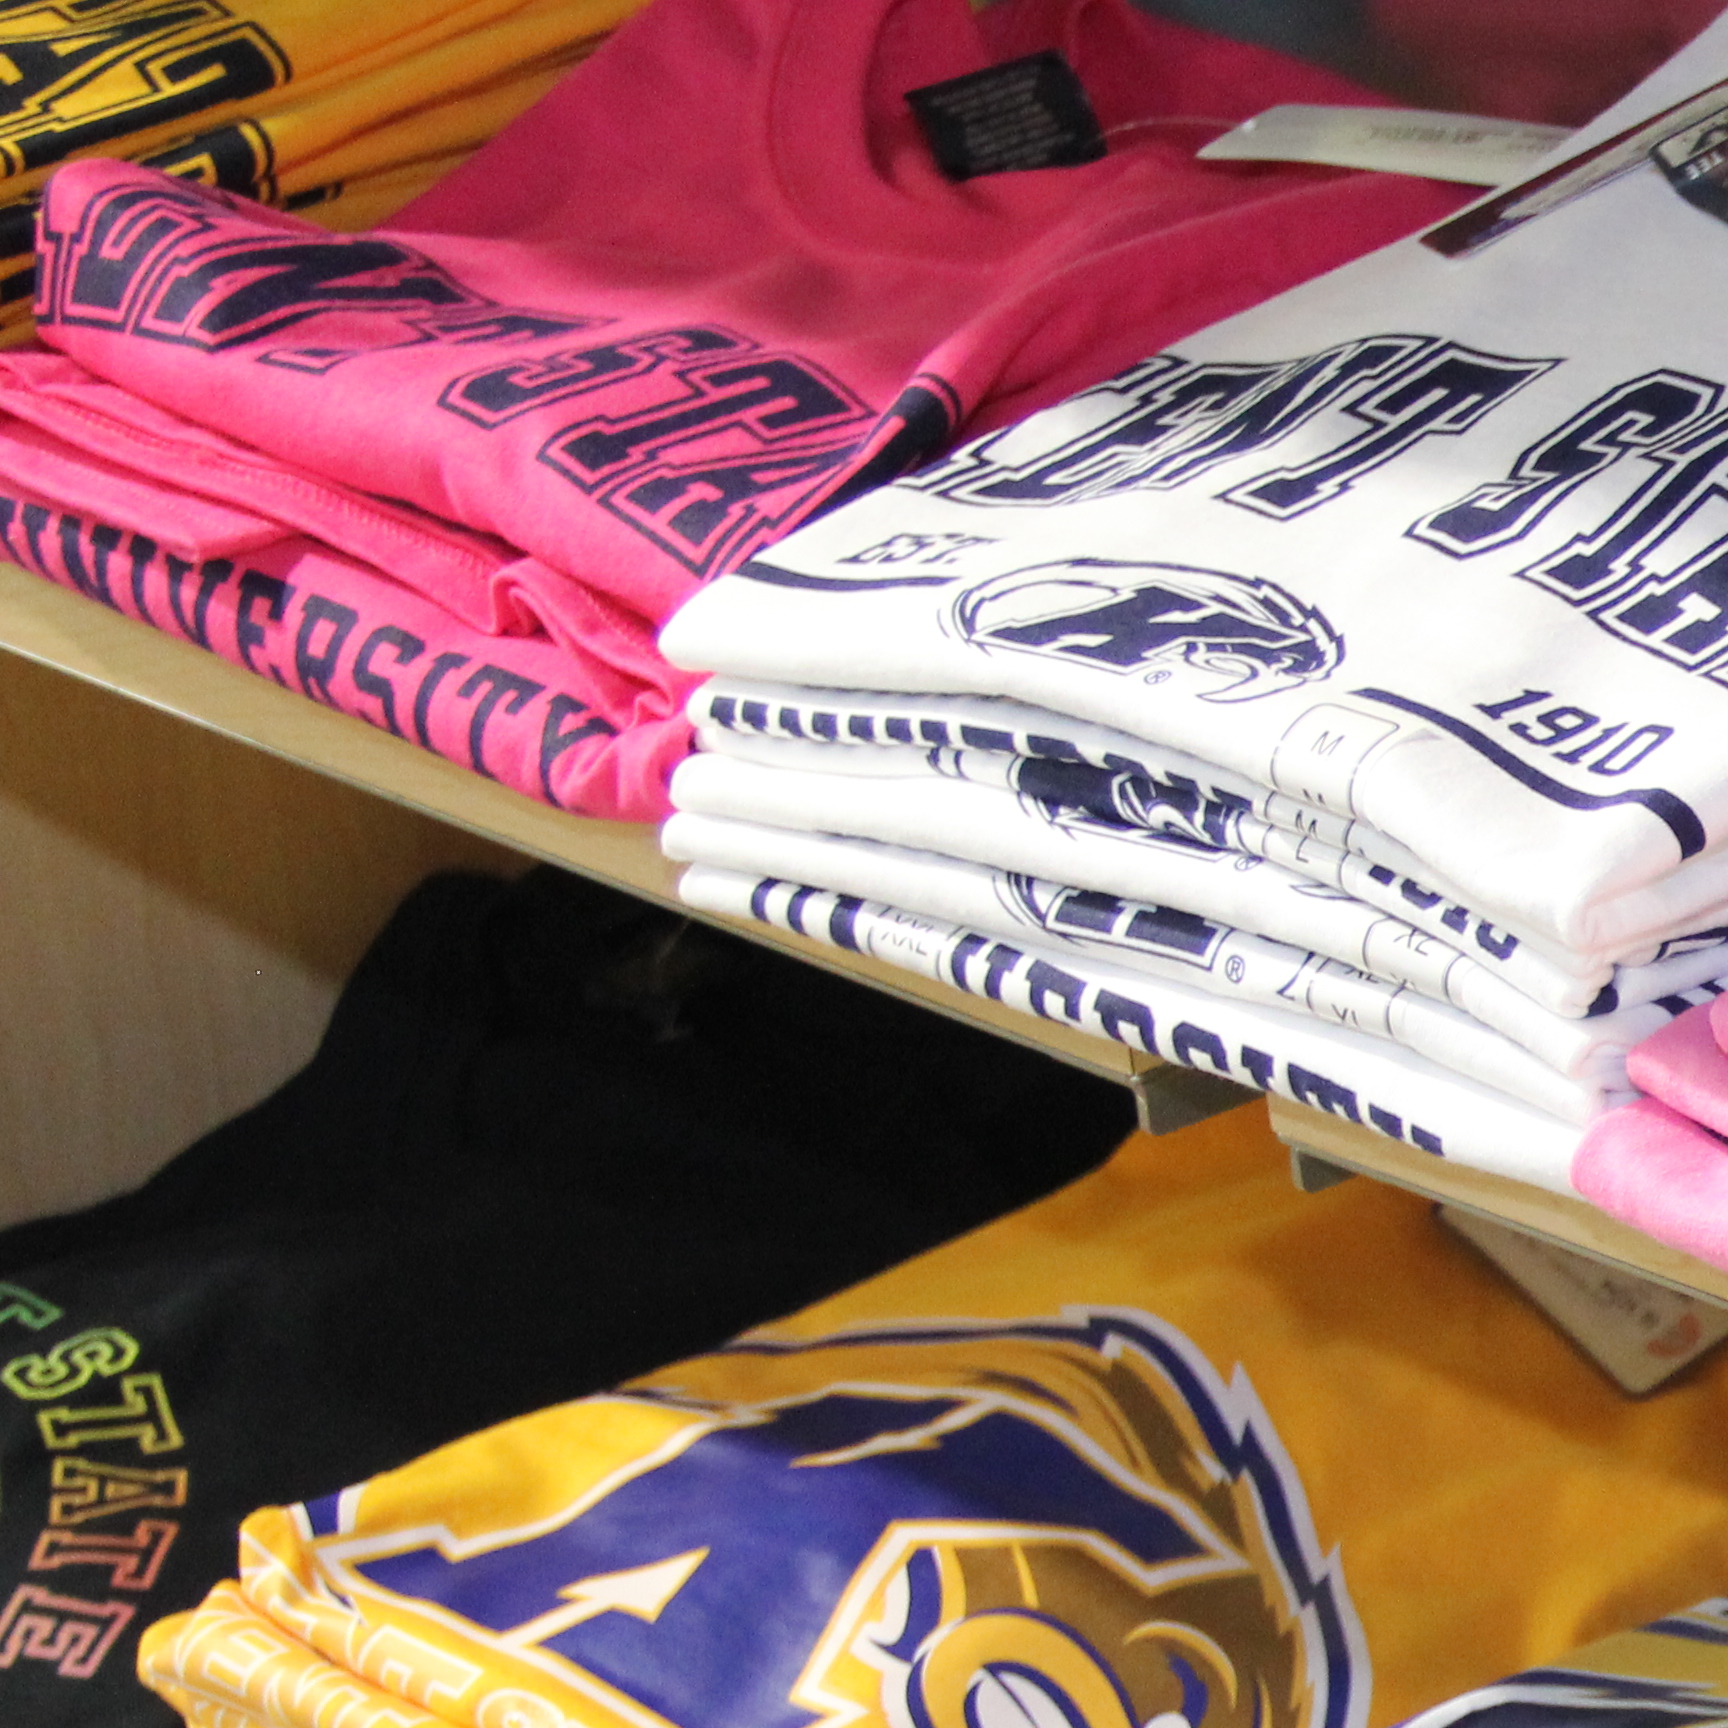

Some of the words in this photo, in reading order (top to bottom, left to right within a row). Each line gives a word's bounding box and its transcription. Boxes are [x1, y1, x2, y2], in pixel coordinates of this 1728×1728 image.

[1683, 148, 1725, 181] TEE
[1310, 730, 1346, 758] M
[1472, 687, 1675, 777] 1910
